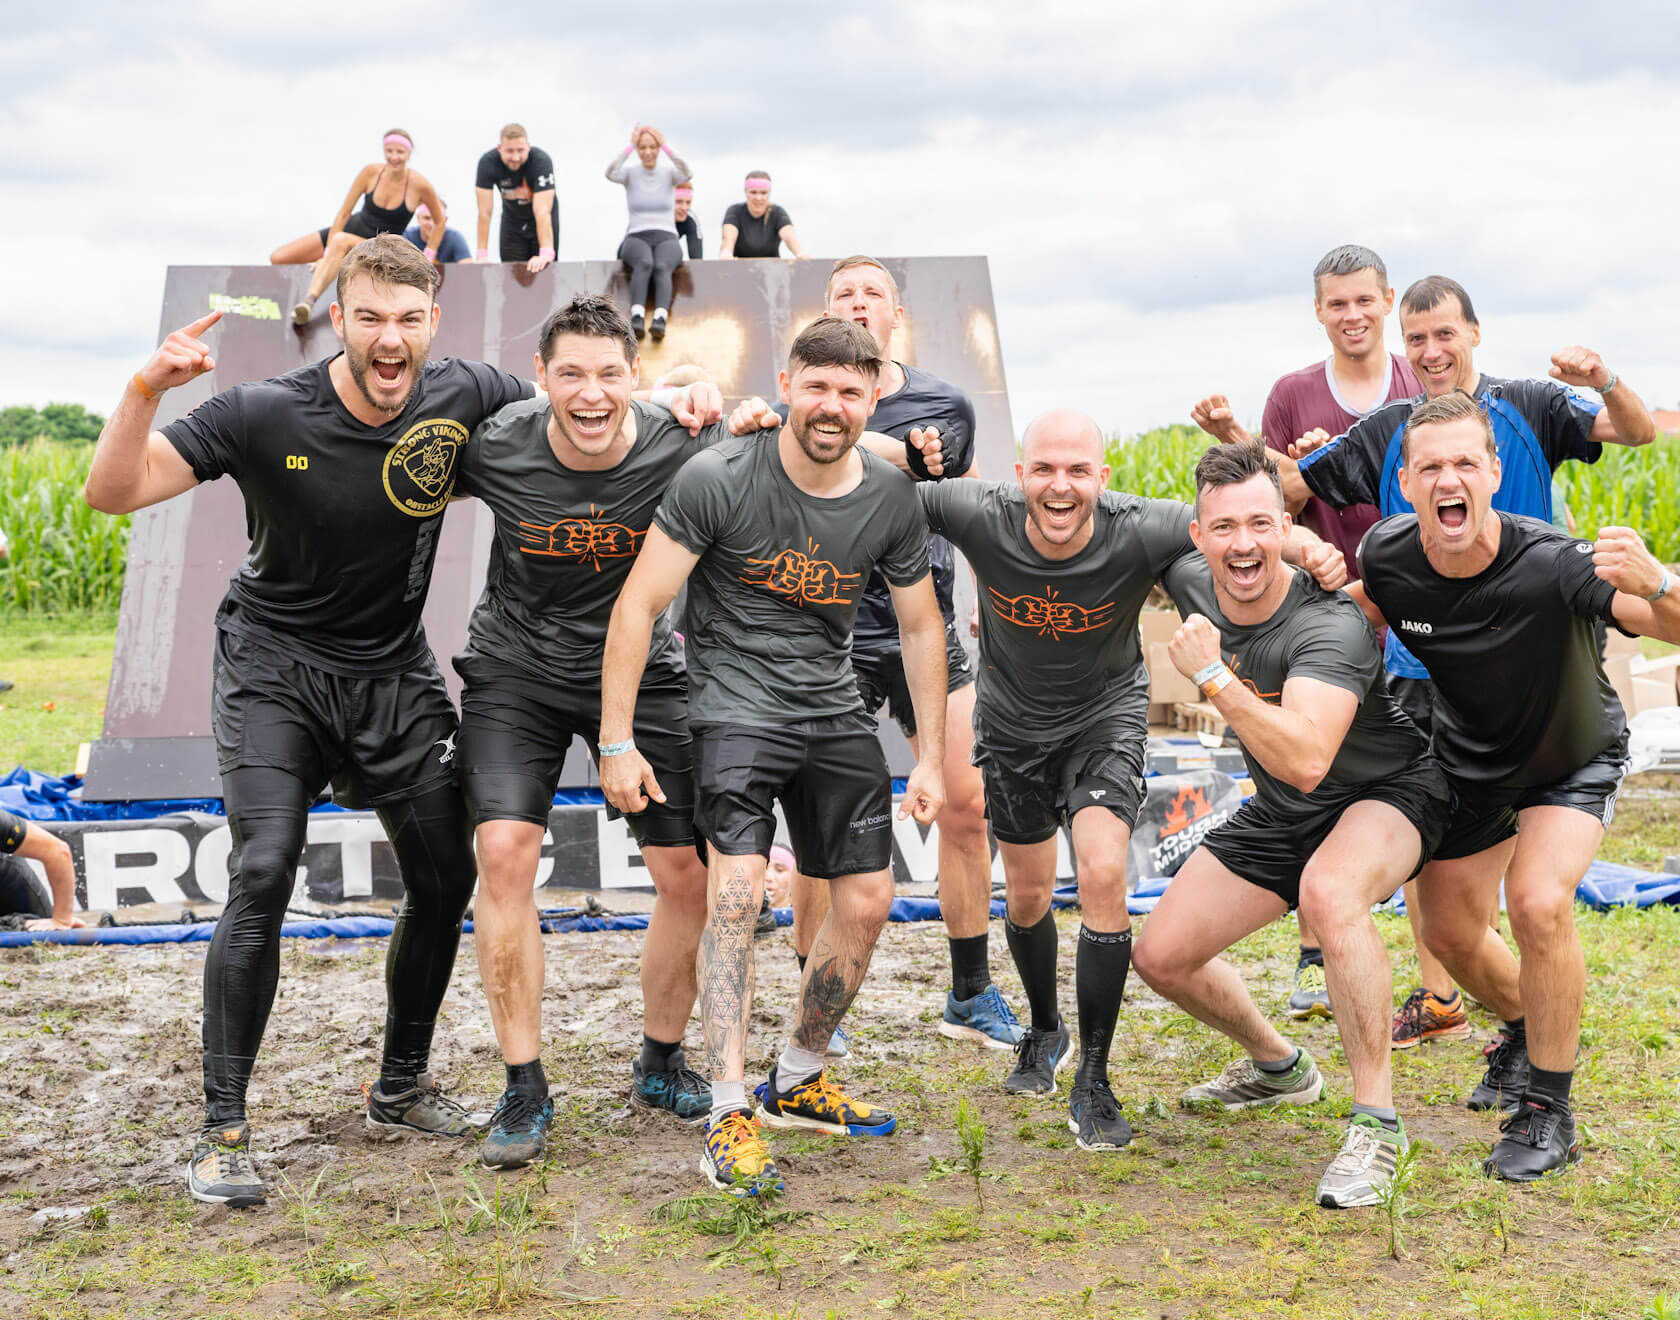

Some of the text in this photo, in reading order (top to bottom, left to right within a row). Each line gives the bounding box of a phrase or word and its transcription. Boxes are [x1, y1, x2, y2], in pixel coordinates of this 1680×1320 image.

[391, 425, 465, 466] STRONG VIKING
[1401, 619, 1432, 634] JAKO
[850, 819, 866, 829] new
[1149, 809, 1228, 859] TOUGH
[1154, 821, 1226, 873] MUDD
